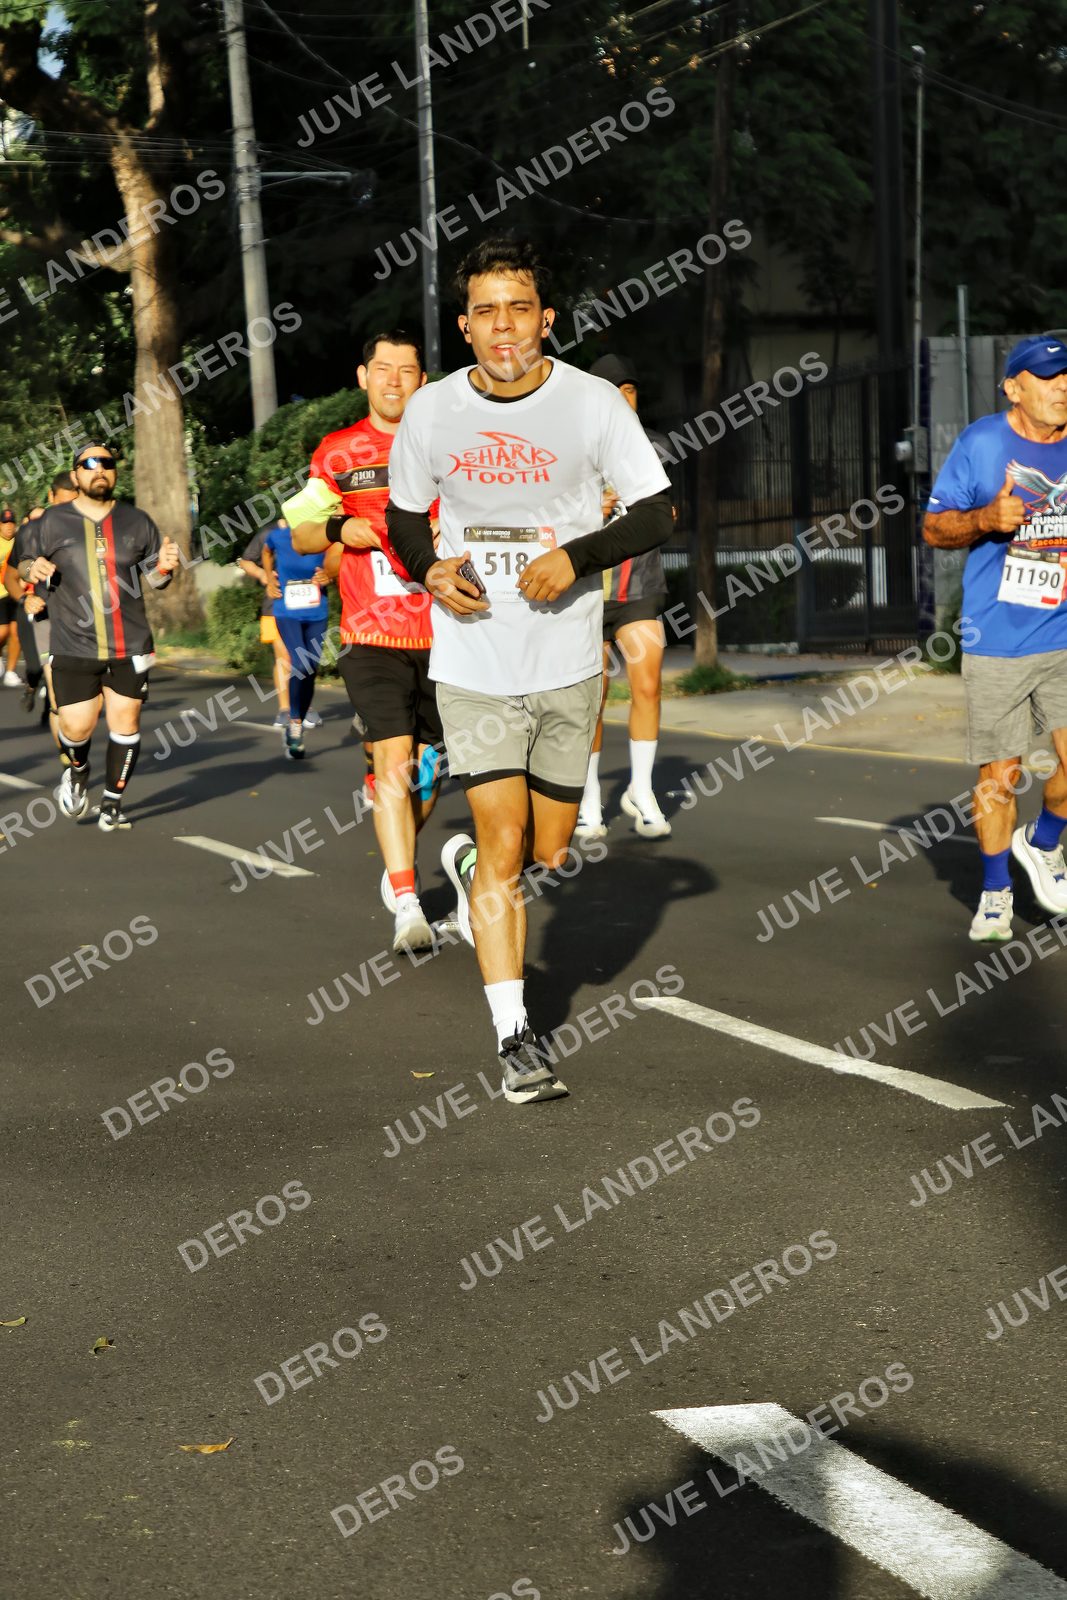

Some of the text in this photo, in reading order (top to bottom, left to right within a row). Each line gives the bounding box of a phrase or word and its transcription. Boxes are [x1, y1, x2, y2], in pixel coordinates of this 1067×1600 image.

[463, 444, 545, 467] SHARK
[462, 468, 550, 484] TOOTH
[484, 552, 528, 575] 518
[1006, 565, 1060, 588] 11190
